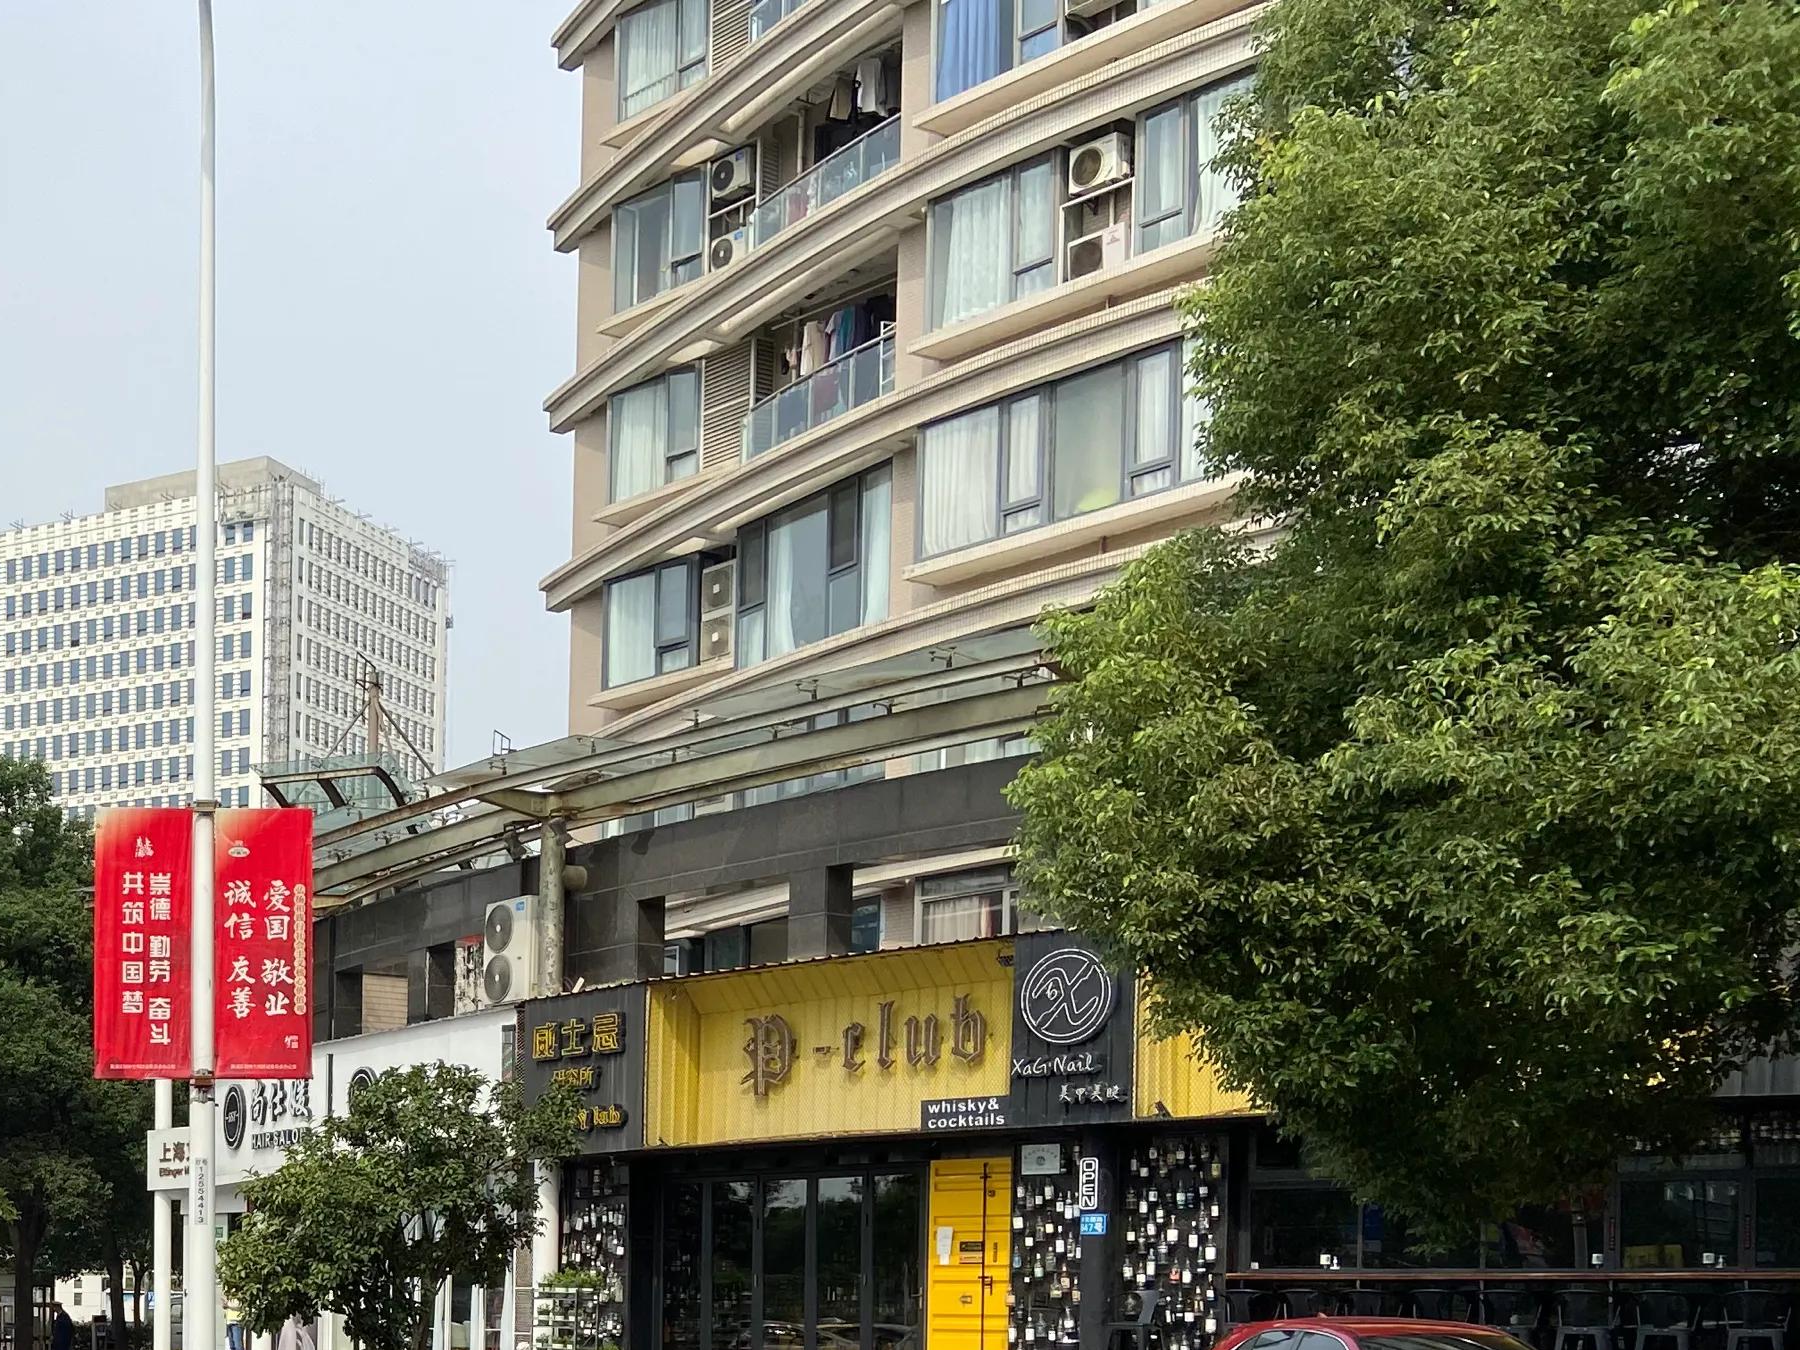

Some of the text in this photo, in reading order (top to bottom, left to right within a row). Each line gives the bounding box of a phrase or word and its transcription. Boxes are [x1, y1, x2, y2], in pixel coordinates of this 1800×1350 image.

[224, 879, 256, 941] 诚信
[263, 879, 291, 941] 爱国
[122, 871, 145, 1014] 共筑中国梦
[148, 872, 172, 1046] 崇德 勤劳 奋斗
[226, 955, 256, 1019] 友善
[261, 958, 294, 1016] 敬业
[532, 1012, 621, 1060] 威士忌
[928, 1097, 1001, 1115] whisky&
[928, 1112, 1005, 1129] cocktails
[1082, 1160, 1095, 1207] OPEN
